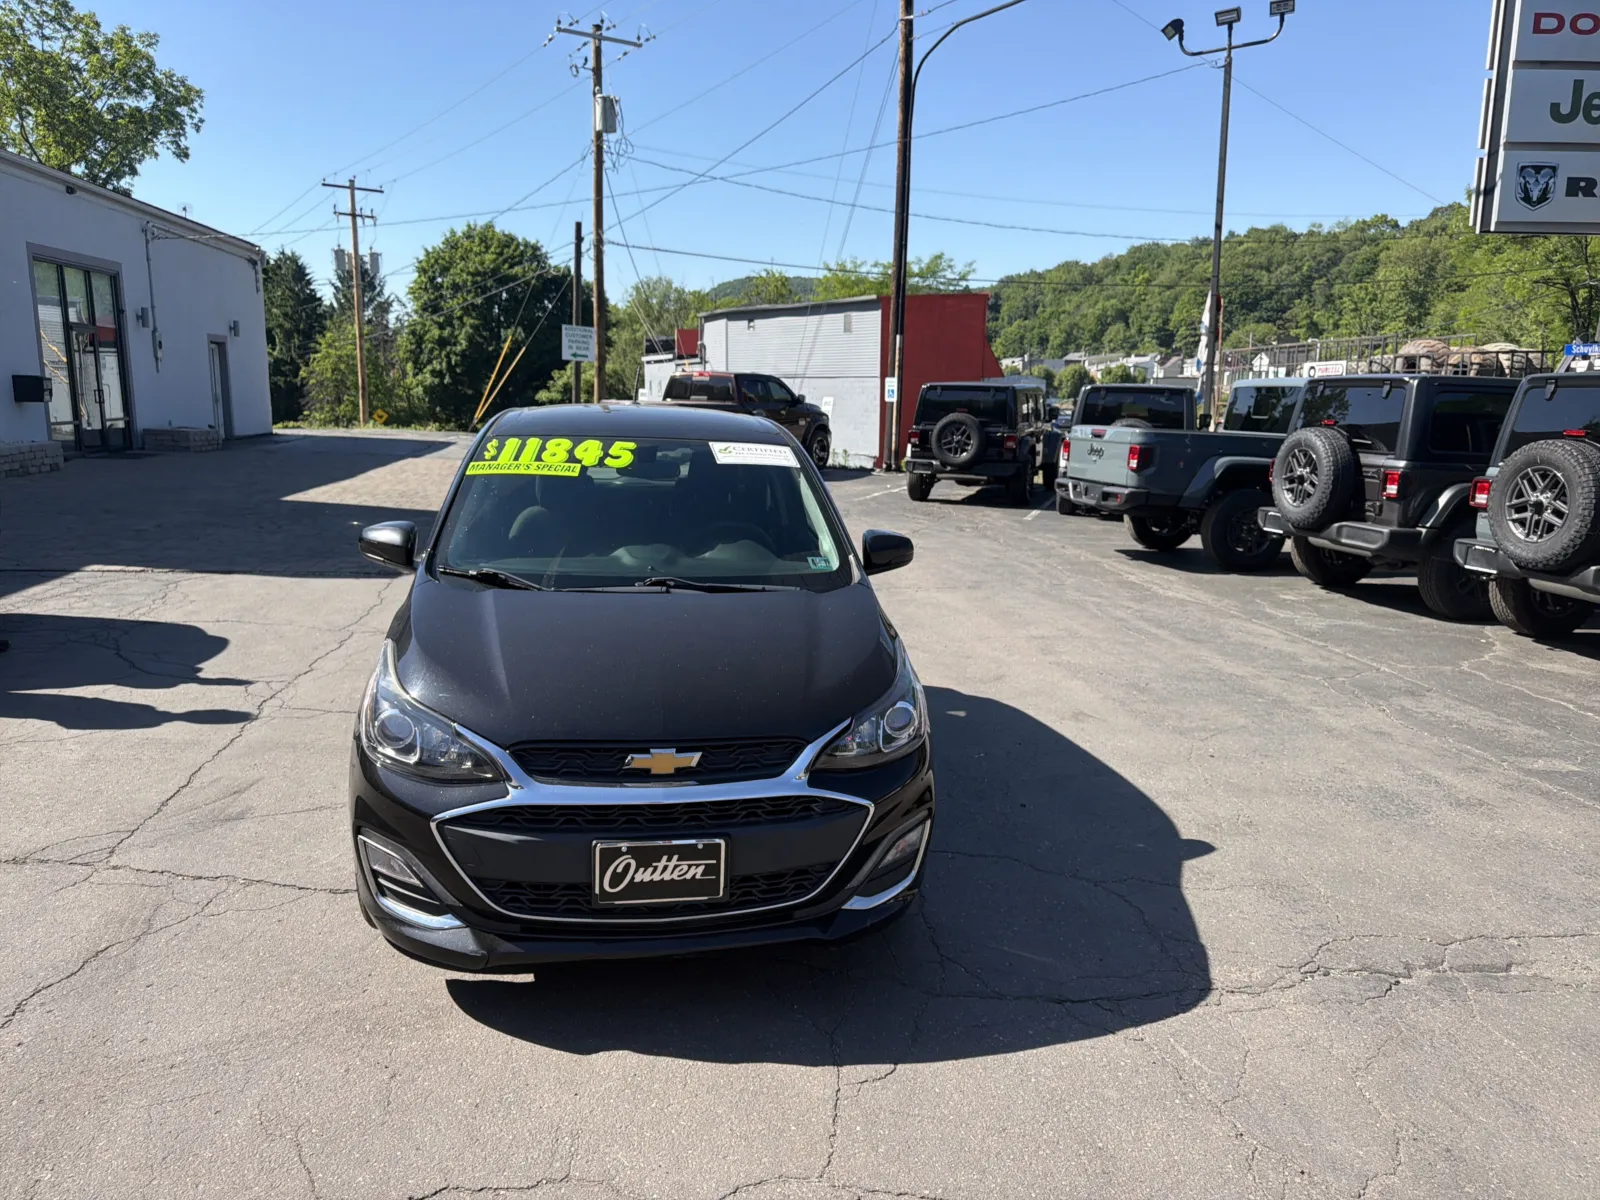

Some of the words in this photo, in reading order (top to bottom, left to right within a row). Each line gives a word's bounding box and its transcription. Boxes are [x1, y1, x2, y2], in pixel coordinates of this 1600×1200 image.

[1532, 12, 1600, 35] DO
[1549, 79, 1600, 125] Je
[1565, 176, 1600, 198] R
[483, 437, 637, 468] $11845
[468, 463, 531, 472] MANAGER'S
[533, 463, 578, 474] SPECIAL
[602, 854, 717, 893] Outten
